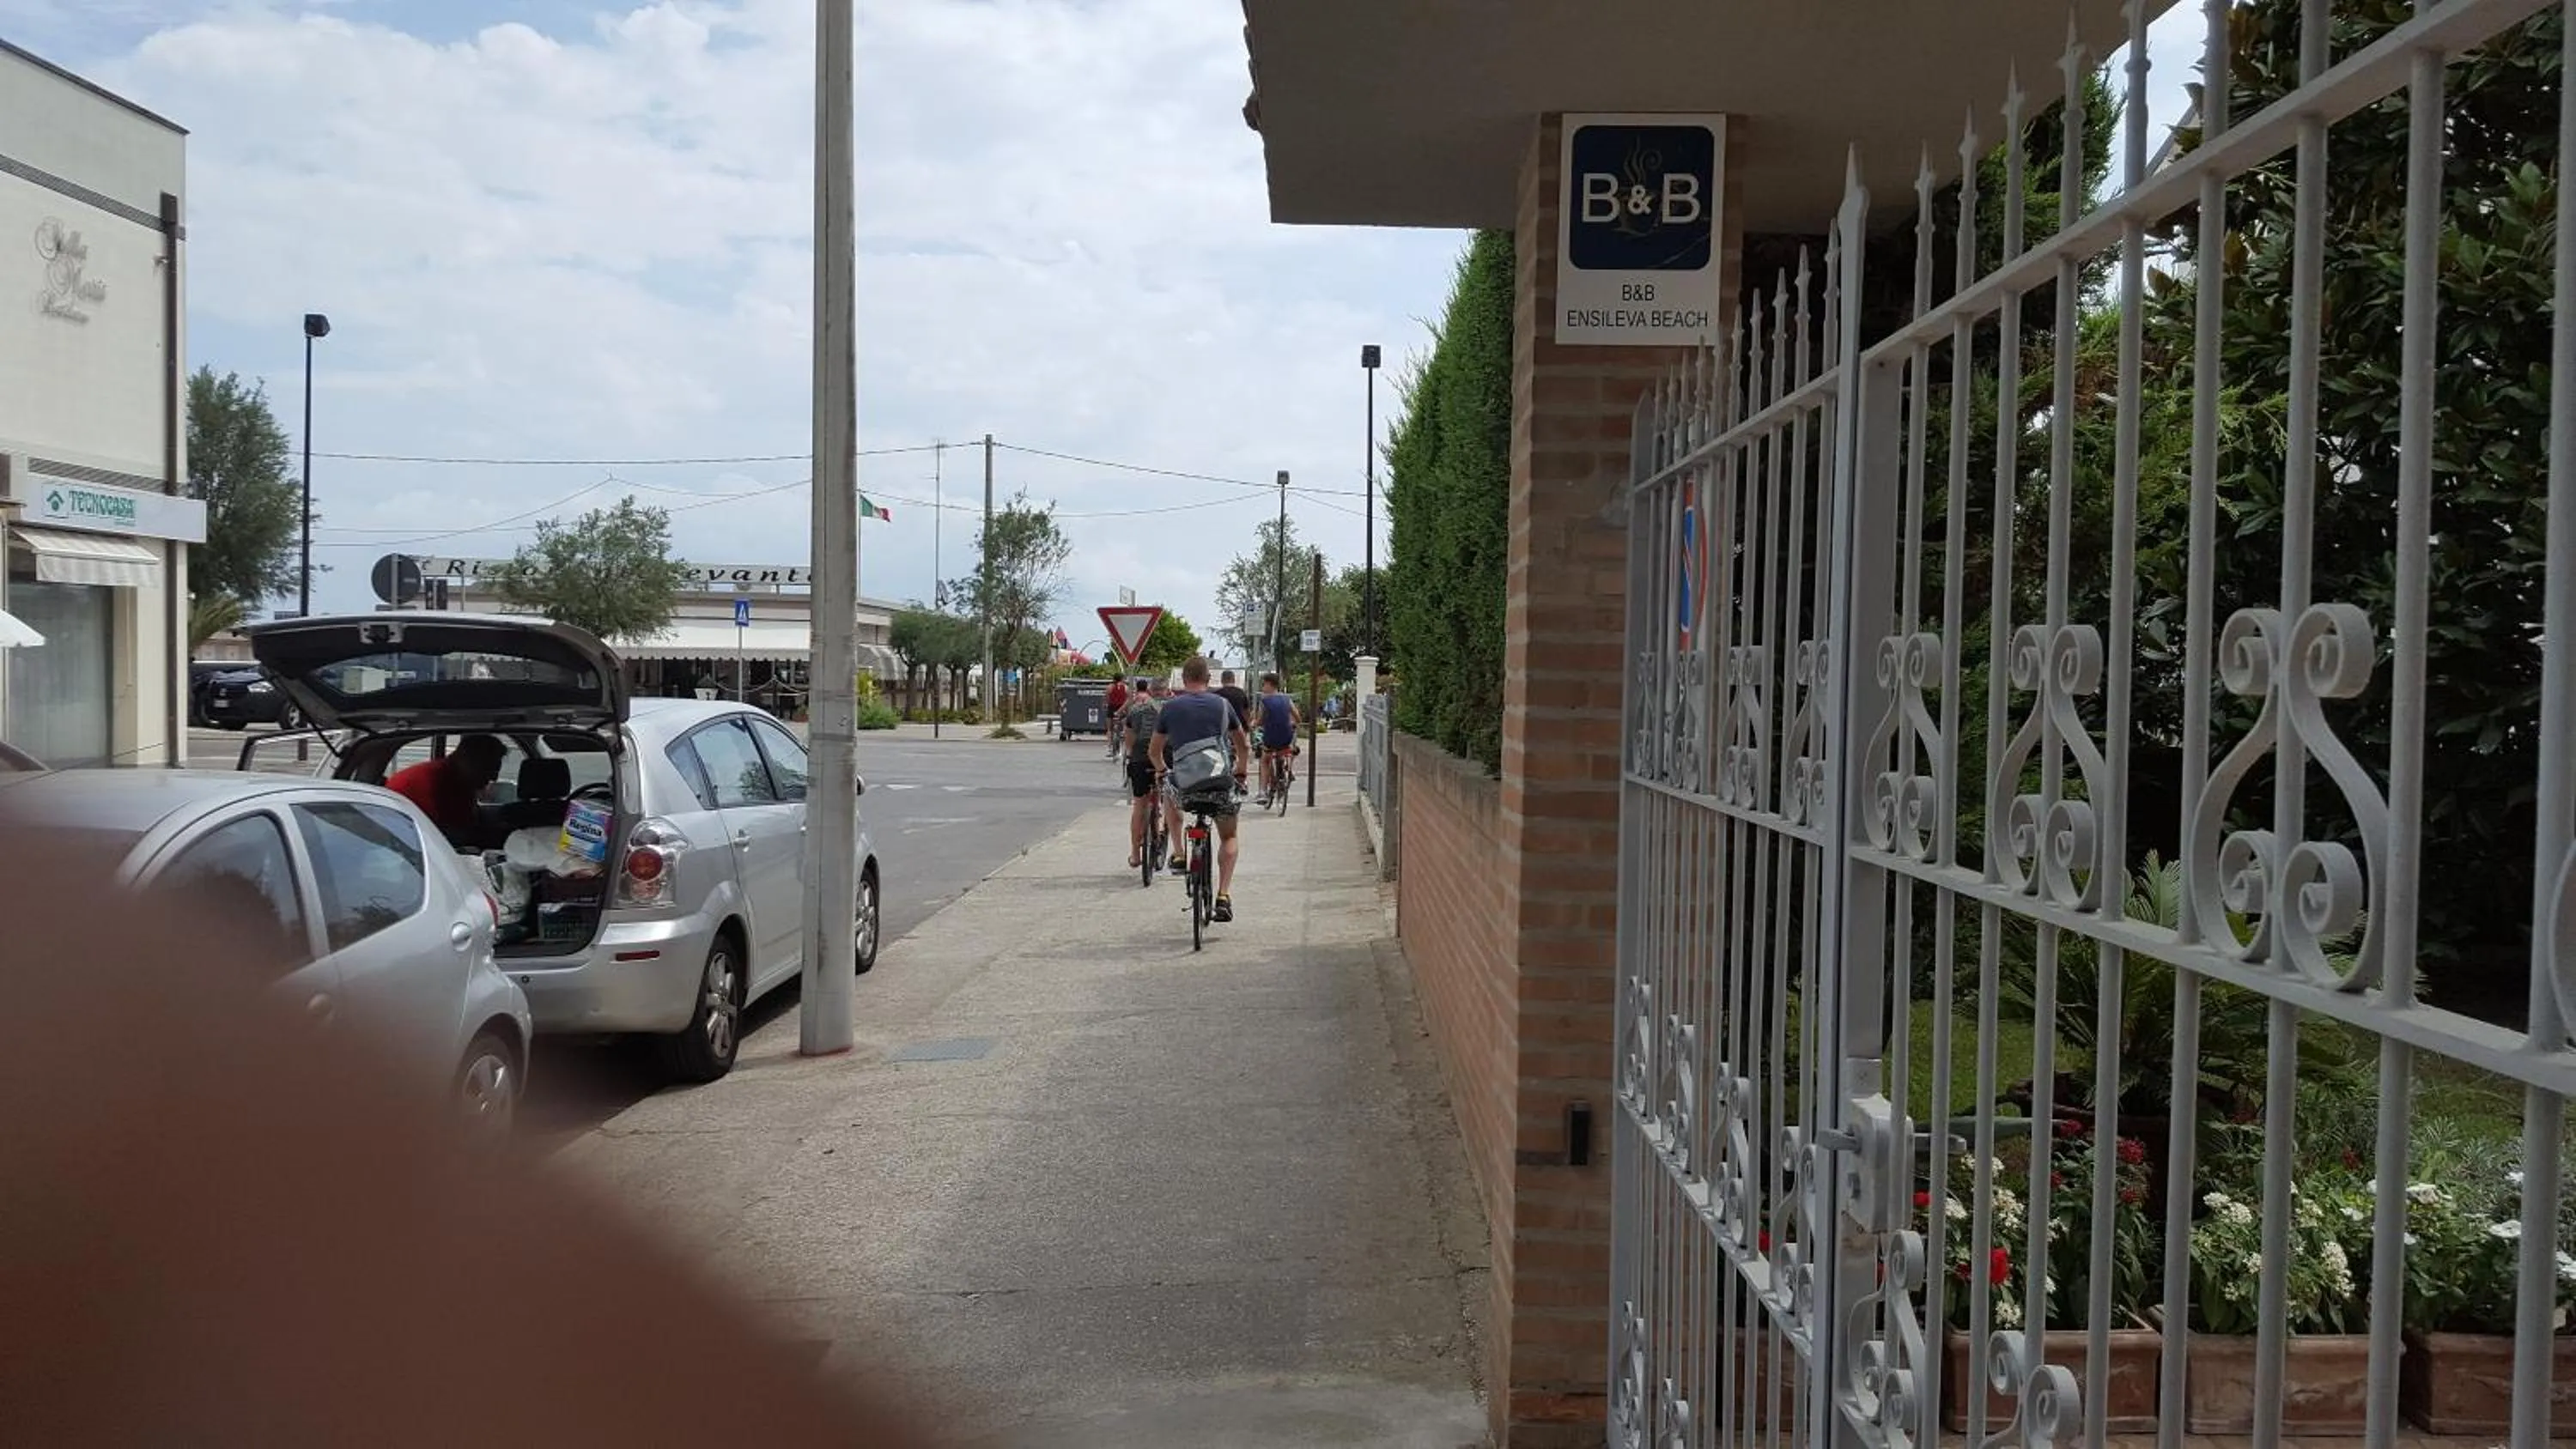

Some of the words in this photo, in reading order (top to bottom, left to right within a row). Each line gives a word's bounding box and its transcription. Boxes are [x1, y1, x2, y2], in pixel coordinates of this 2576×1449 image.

[1582, 173, 1701, 224] B&B
[1621, 284, 1656, 301] B&B
[1566, 310, 1647, 327] ENSILEVA
[1650, 310, 1708, 328] BEACH
